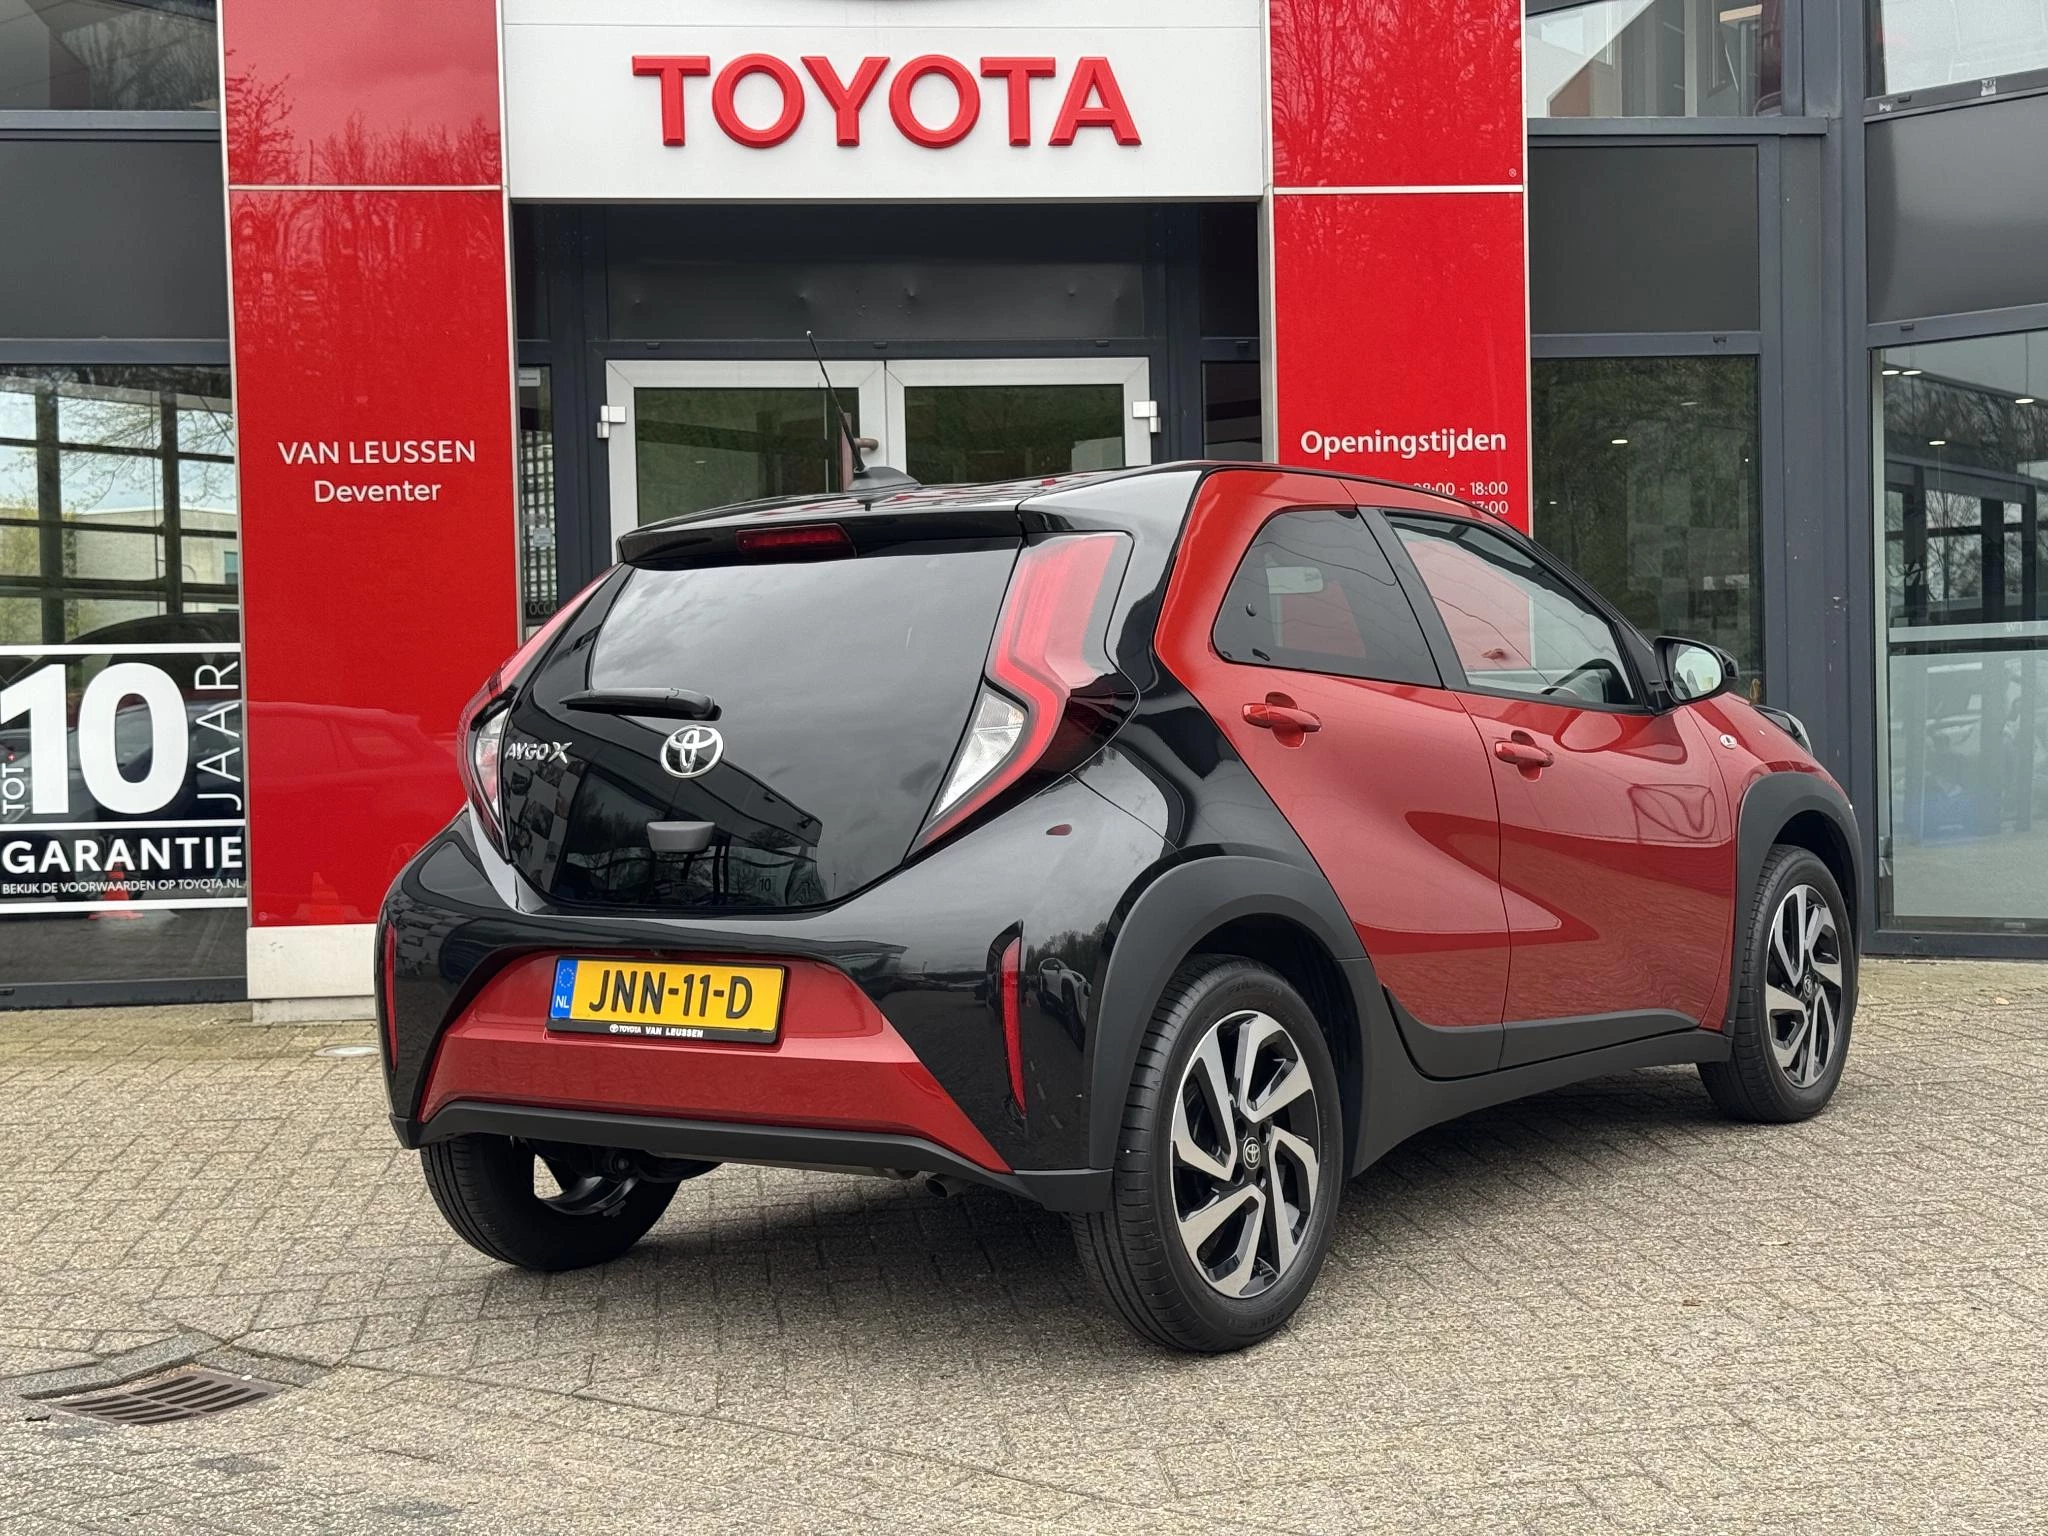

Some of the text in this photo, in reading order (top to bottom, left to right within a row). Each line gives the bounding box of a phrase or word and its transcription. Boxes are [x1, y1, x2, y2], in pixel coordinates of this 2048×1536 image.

[631, 53, 1142, 148] TOYOTA
[278, 439, 476, 464] VAN LEUSSEN
[1300, 428, 1507, 461] Openingstijden
[314, 479, 442, 503] Deventer
[1413, 482, 1456, 496] :00
[1470, 481, 1508, 496] 18:00
[0, 662, 189, 814] 10
[194, 661, 243, 812] JAAR
[2, 763, 25, 815] TOT
[2, 836, 243, 874] GARANTIE
[2, 878, 242, 895] BEKIJK DE VOORWAARDEN OP TOYOTA.NL
[555, 995, 570, 1009] NL
[588, 969, 753, 1019] JNN-11-D
[619, 1025, 704, 1038] TOYOTA VAN LEUSSEN
